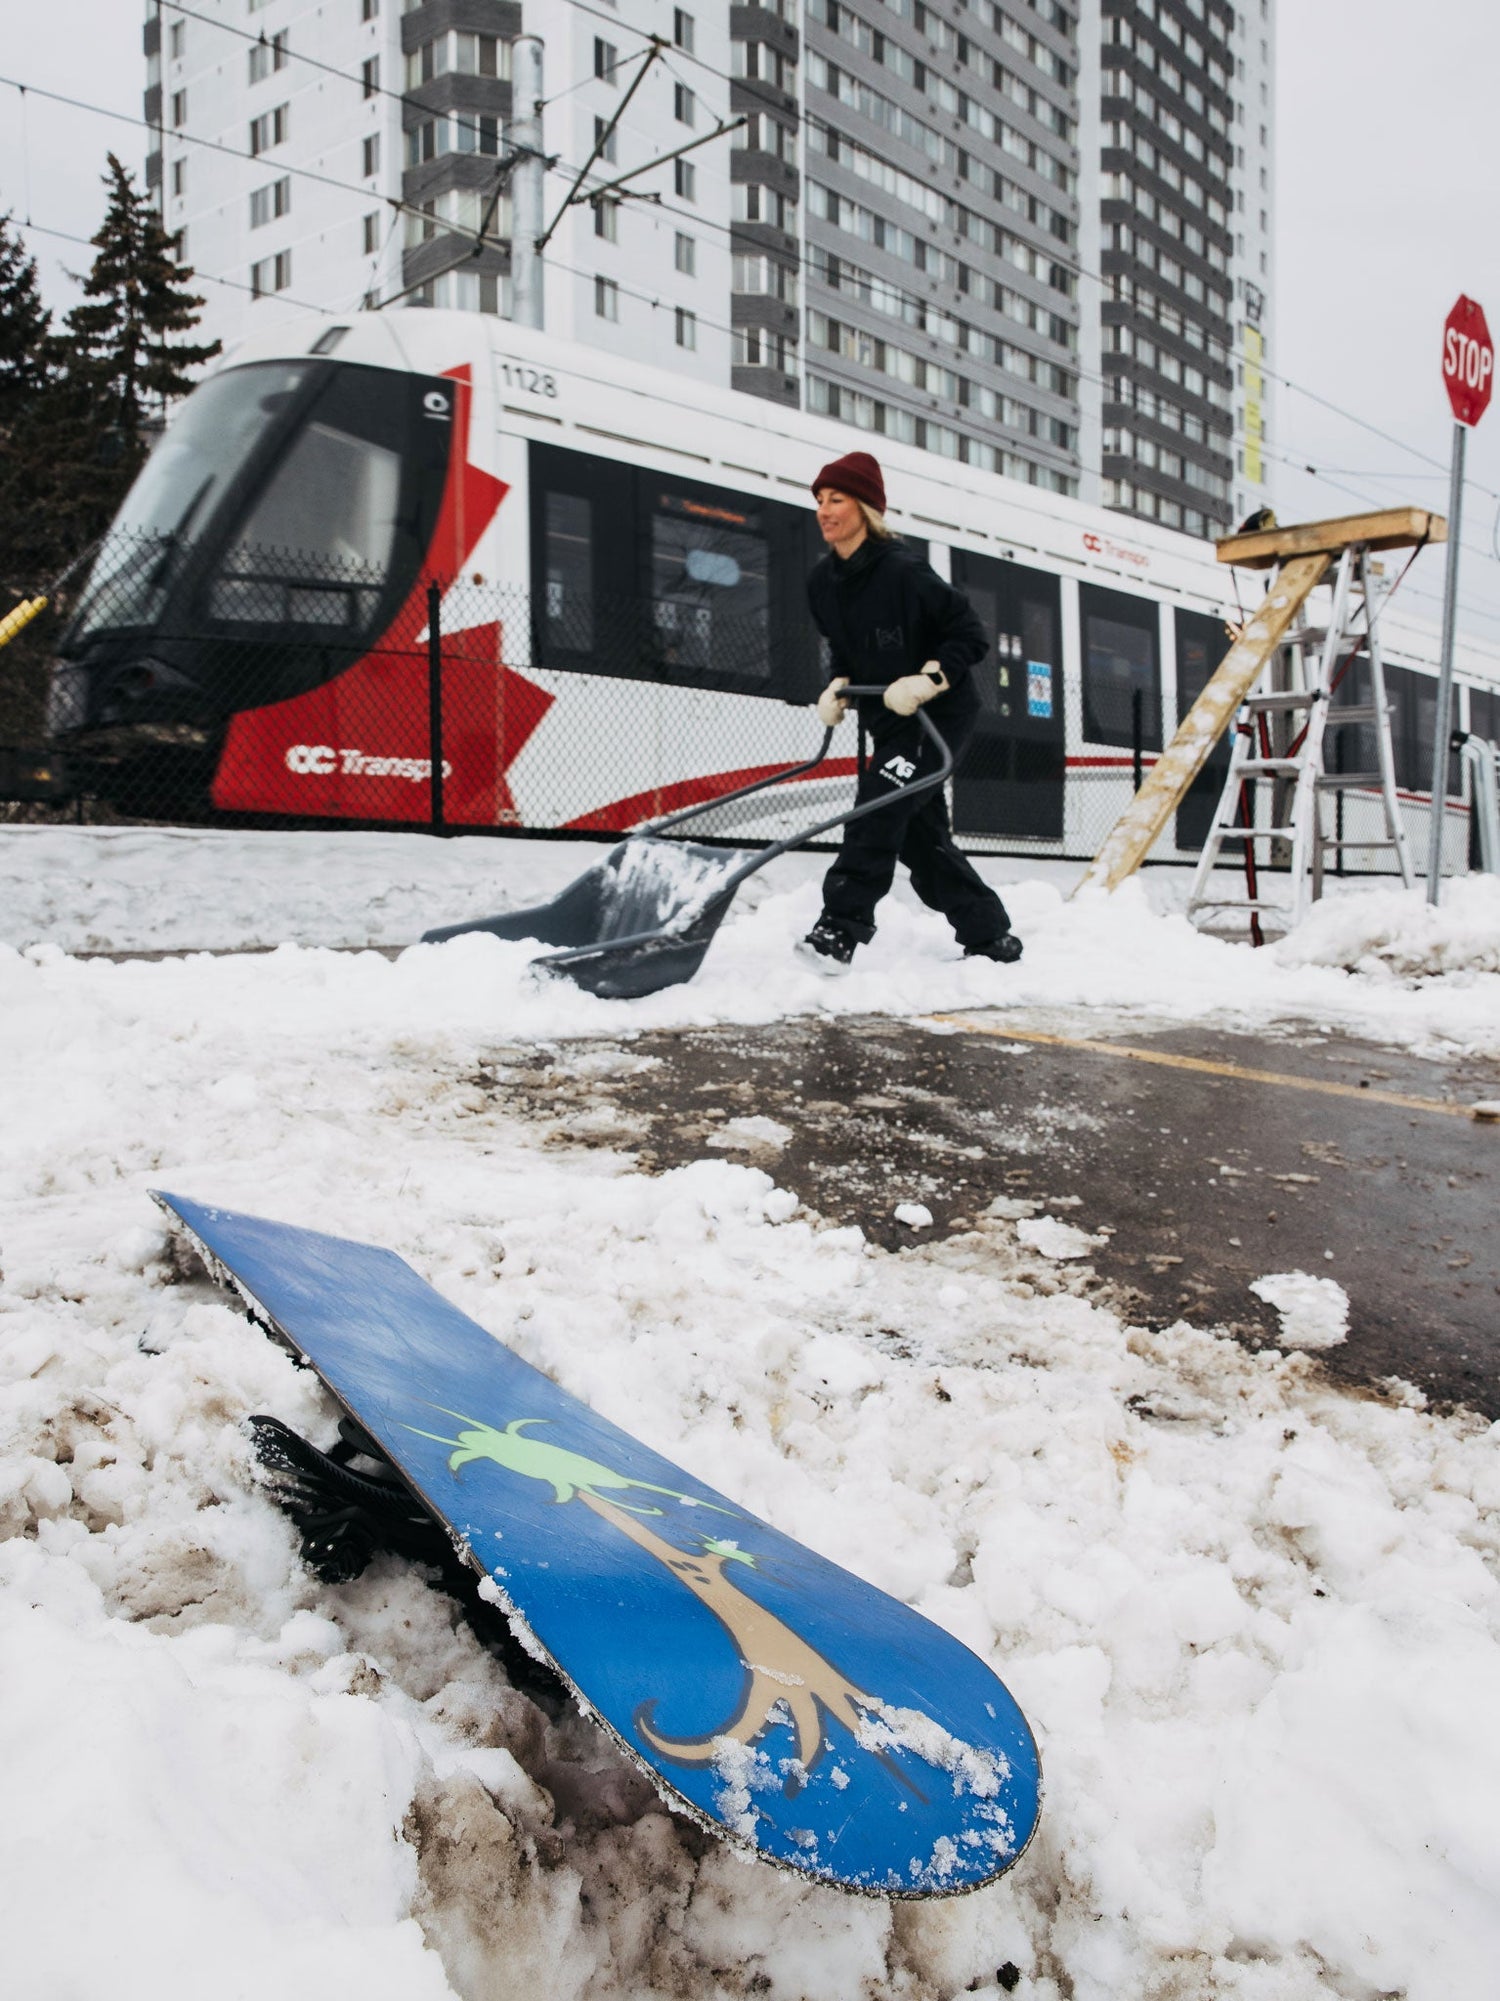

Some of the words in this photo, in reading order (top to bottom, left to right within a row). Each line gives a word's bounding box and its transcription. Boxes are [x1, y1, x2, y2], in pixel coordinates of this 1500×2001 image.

[1444, 327, 1492, 391] STOP
[501, 363, 557, 399] 1128
[285, 745, 337, 774] OC
